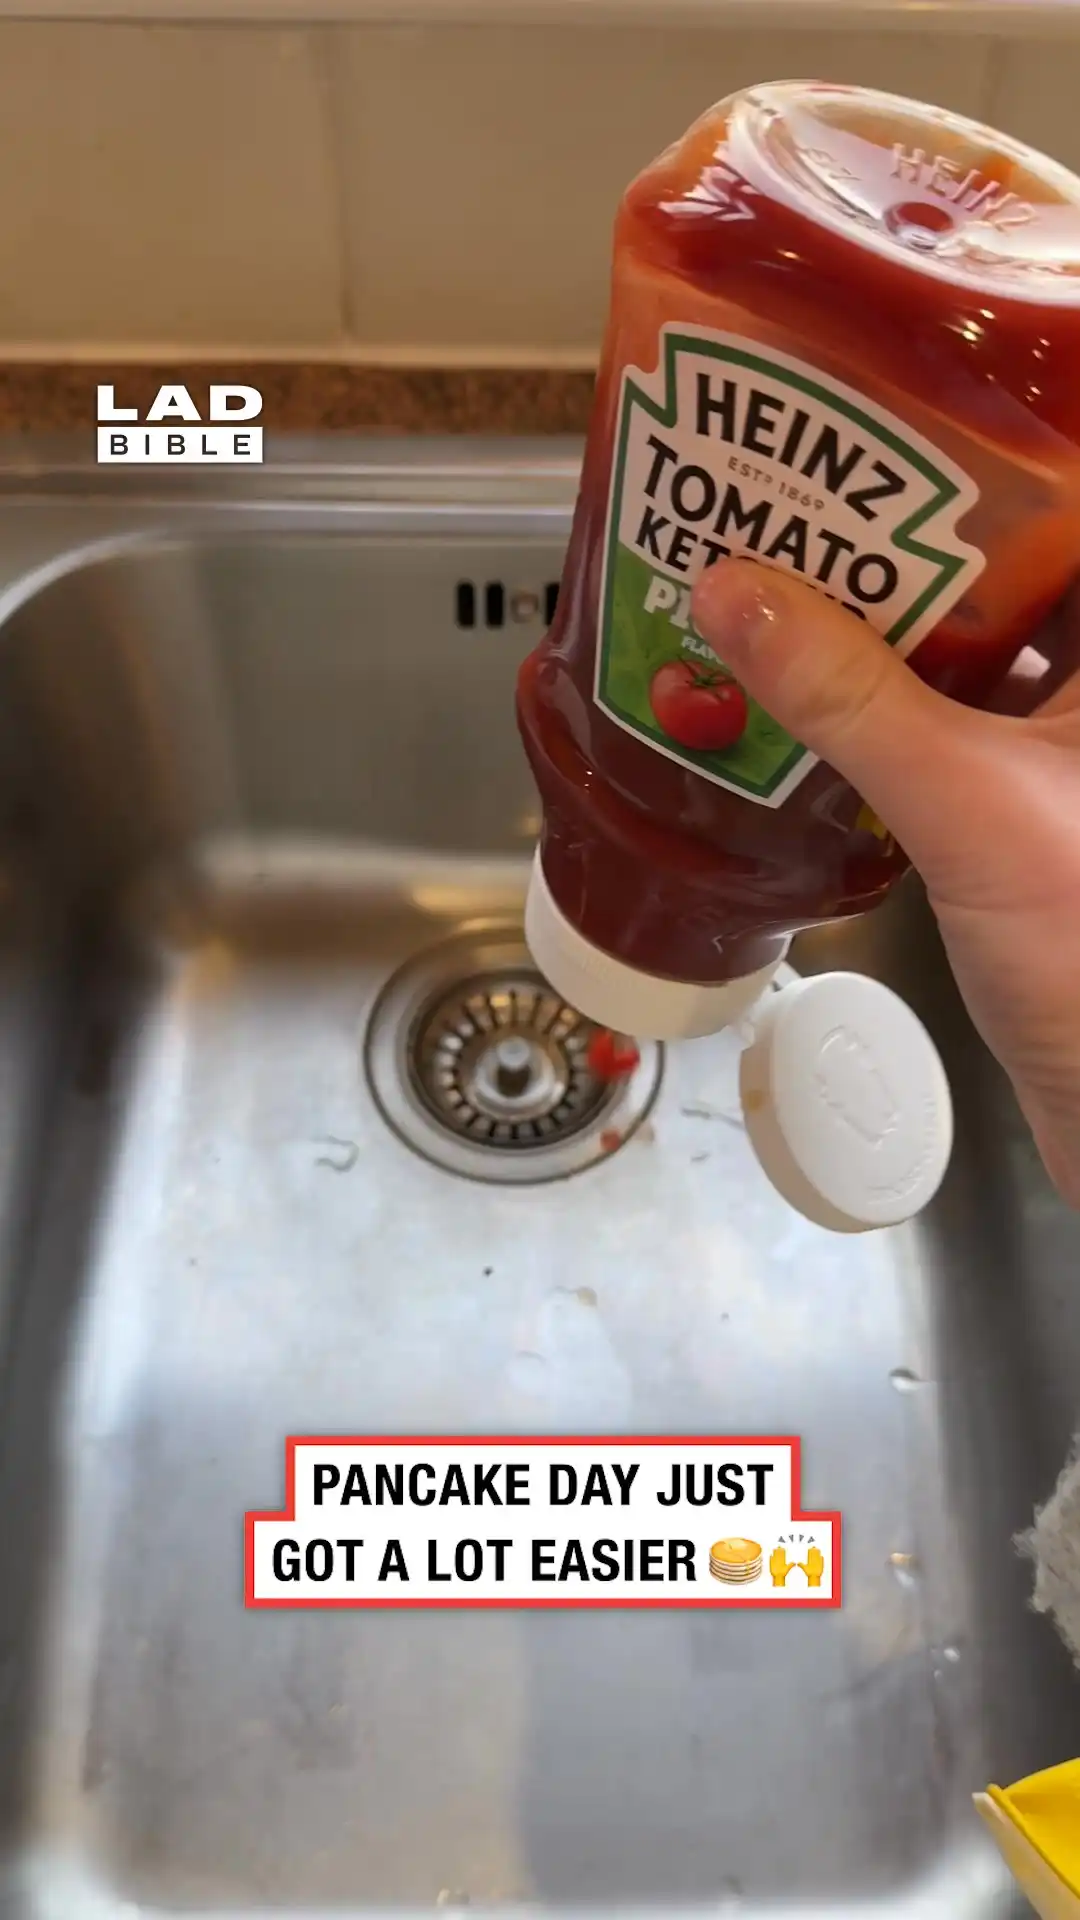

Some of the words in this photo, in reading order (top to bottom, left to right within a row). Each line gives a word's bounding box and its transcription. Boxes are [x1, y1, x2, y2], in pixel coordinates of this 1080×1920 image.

[643, 435, 898, 604] TOMATO
[696, 373, 908, 521] HEINZ
[778, 482, 825, 511] 1869
